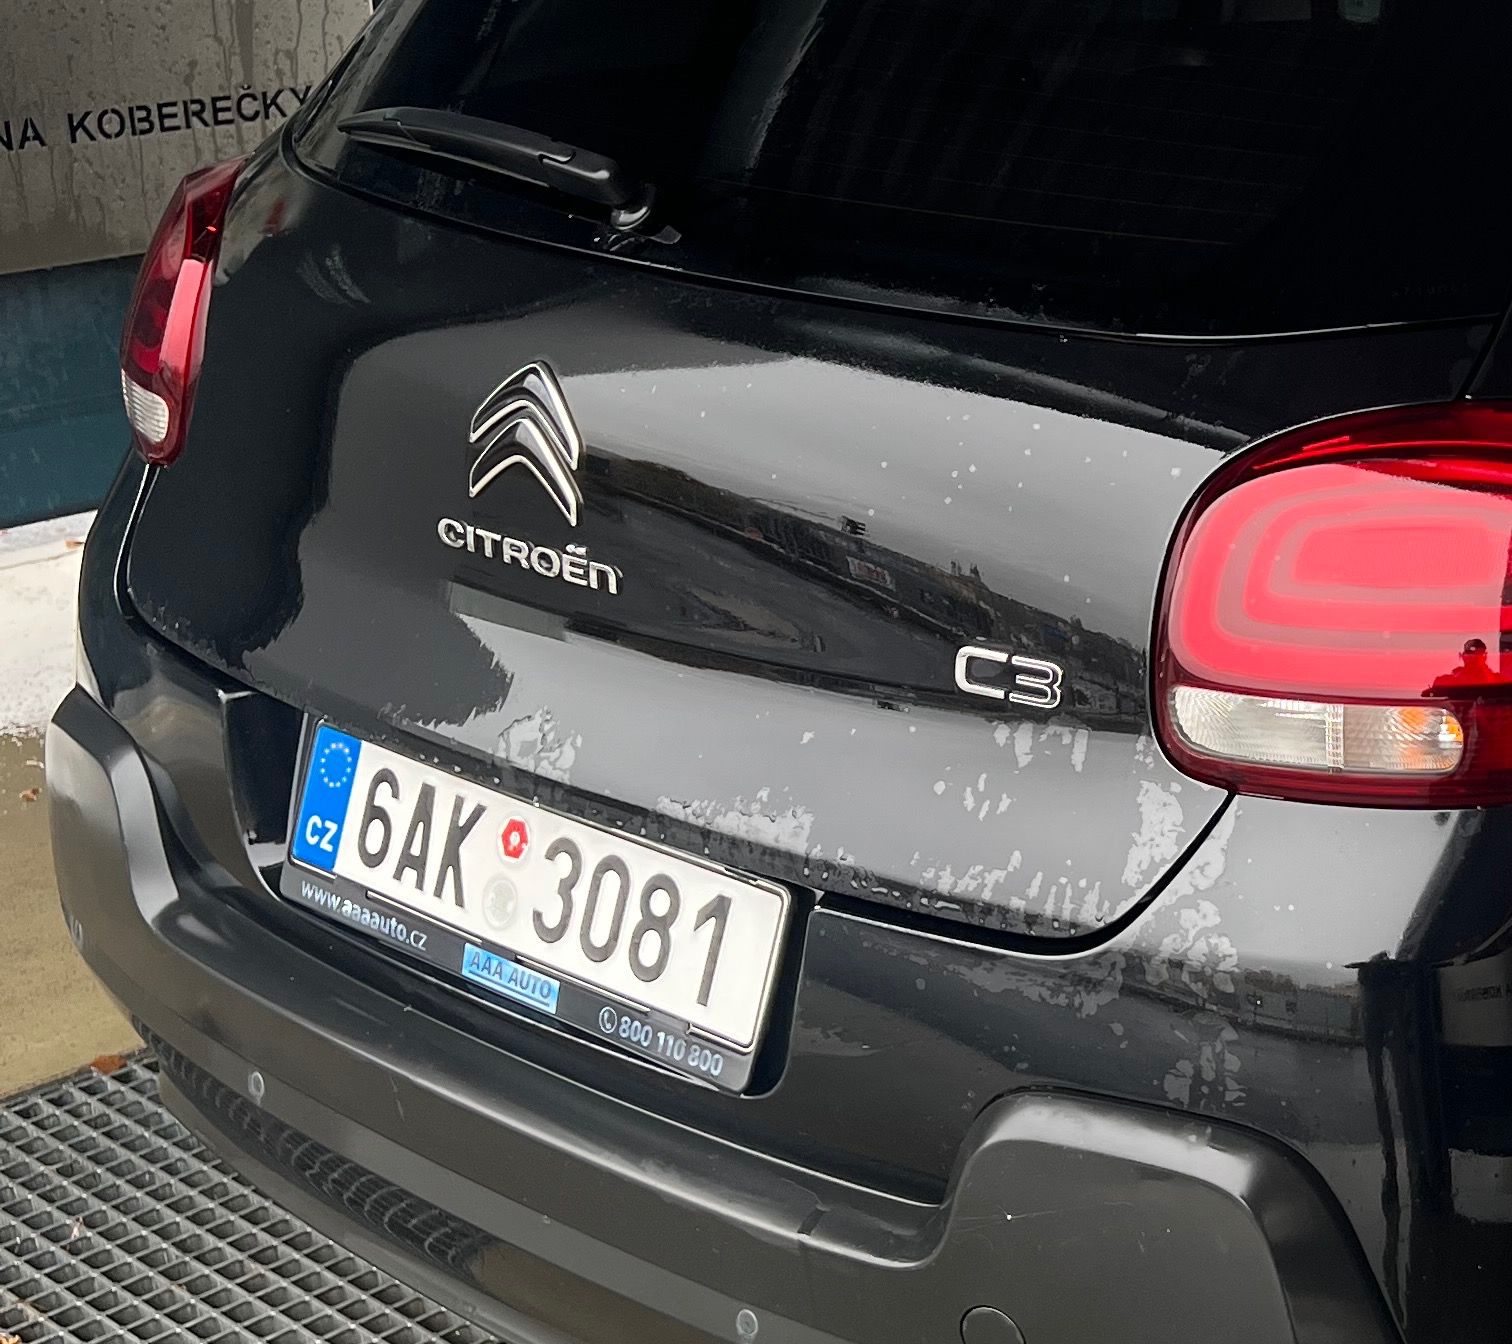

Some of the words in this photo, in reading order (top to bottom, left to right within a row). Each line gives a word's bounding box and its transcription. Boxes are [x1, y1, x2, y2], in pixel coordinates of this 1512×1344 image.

[437, 517, 618, 595] CITROËN
[954, 645, 1063, 709] C3
[300, 880, 428, 952] www.aaaauto.cz
[305, 814, 340, 853] CZ
[356, 766, 487, 910] 6AK
[531, 836, 734, 1008] 3081
[471, 951, 503, 981] AAA
[508, 965, 552, 1000] AUTO
[618, 1015, 653, 1047] 800
[657, 1031, 687, 1061] 110
[687, 1044, 724, 1076] 800
